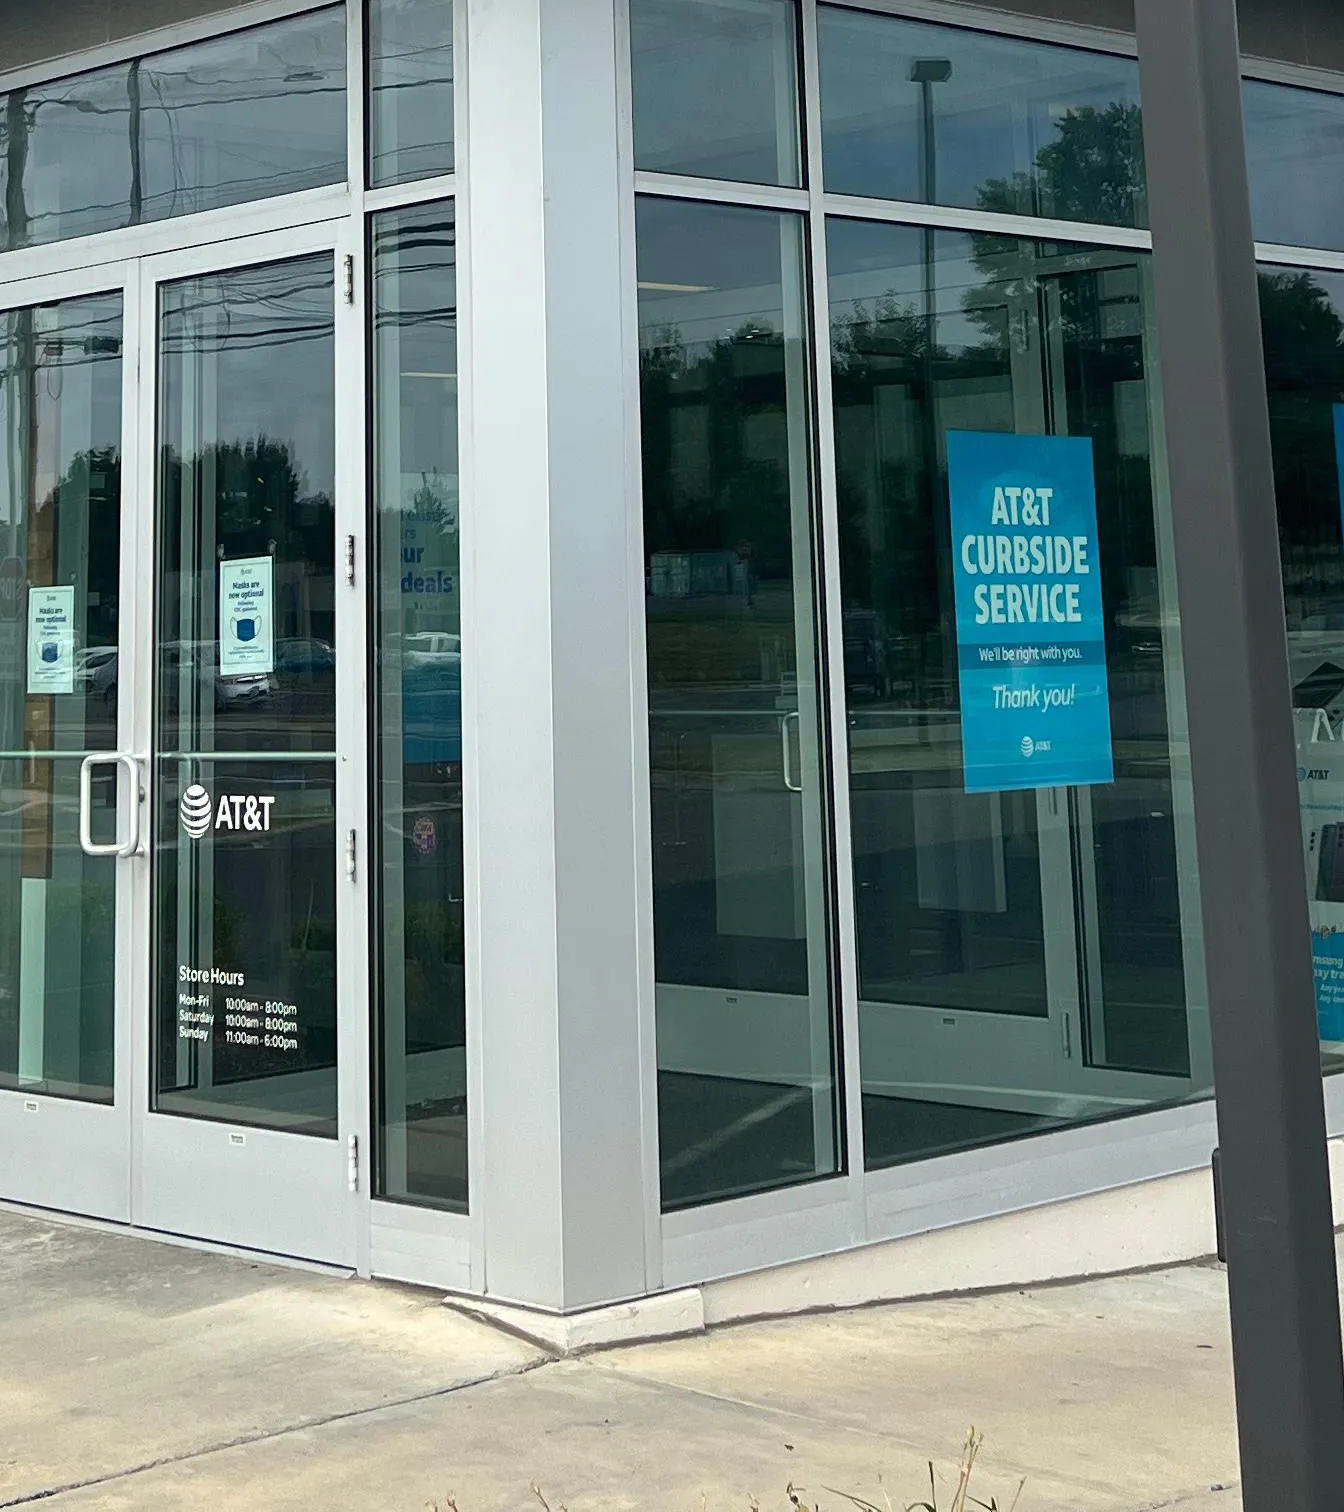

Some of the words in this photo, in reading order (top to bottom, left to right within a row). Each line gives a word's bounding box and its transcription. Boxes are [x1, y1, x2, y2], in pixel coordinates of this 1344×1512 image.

[991, 486, 1053, 526] AT&T
[961, 534, 1090, 575] CURBSIDE
[232, 581, 250, 590] Masks
[401, 571, 453, 593] deals
[241, 589, 264, 599] optional
[974, 583, 1082, 624] SERVICE
[979, 647, 1001, 662] We'll
[1002, 647, 1015, 661] be
[1016, 646, 1039, 664] right
[1040, 645, 1061, 659] with
[1062, 647, 1083, 662] you.
[992, 683, 1041, 709] Thank
[1043, 683, 1075, 713] you!
[1306, 769, 1331, 781] AT&T
[215, 795, 275, 831] AT&T
[179, 965, 209, 983] Store
[210, 968, 245, 986] Hours
[179, 993, 210, 1007] Mon-Fri
[225, 997, 259, 1011] 10:00am
[264, 1001, 297, 1016] 8:00pm
[179, 1009, 215, 1026] Saturday
[225, 1014, 259, 1028] 10:00am
[264, 1017, 297, 1033] 8:00pm
[179, 1026, 209, 1042] Sunday
[225, 1030, 259, 1045] 11:00am
[264, 1034, 298, 1051] 6:00pm
